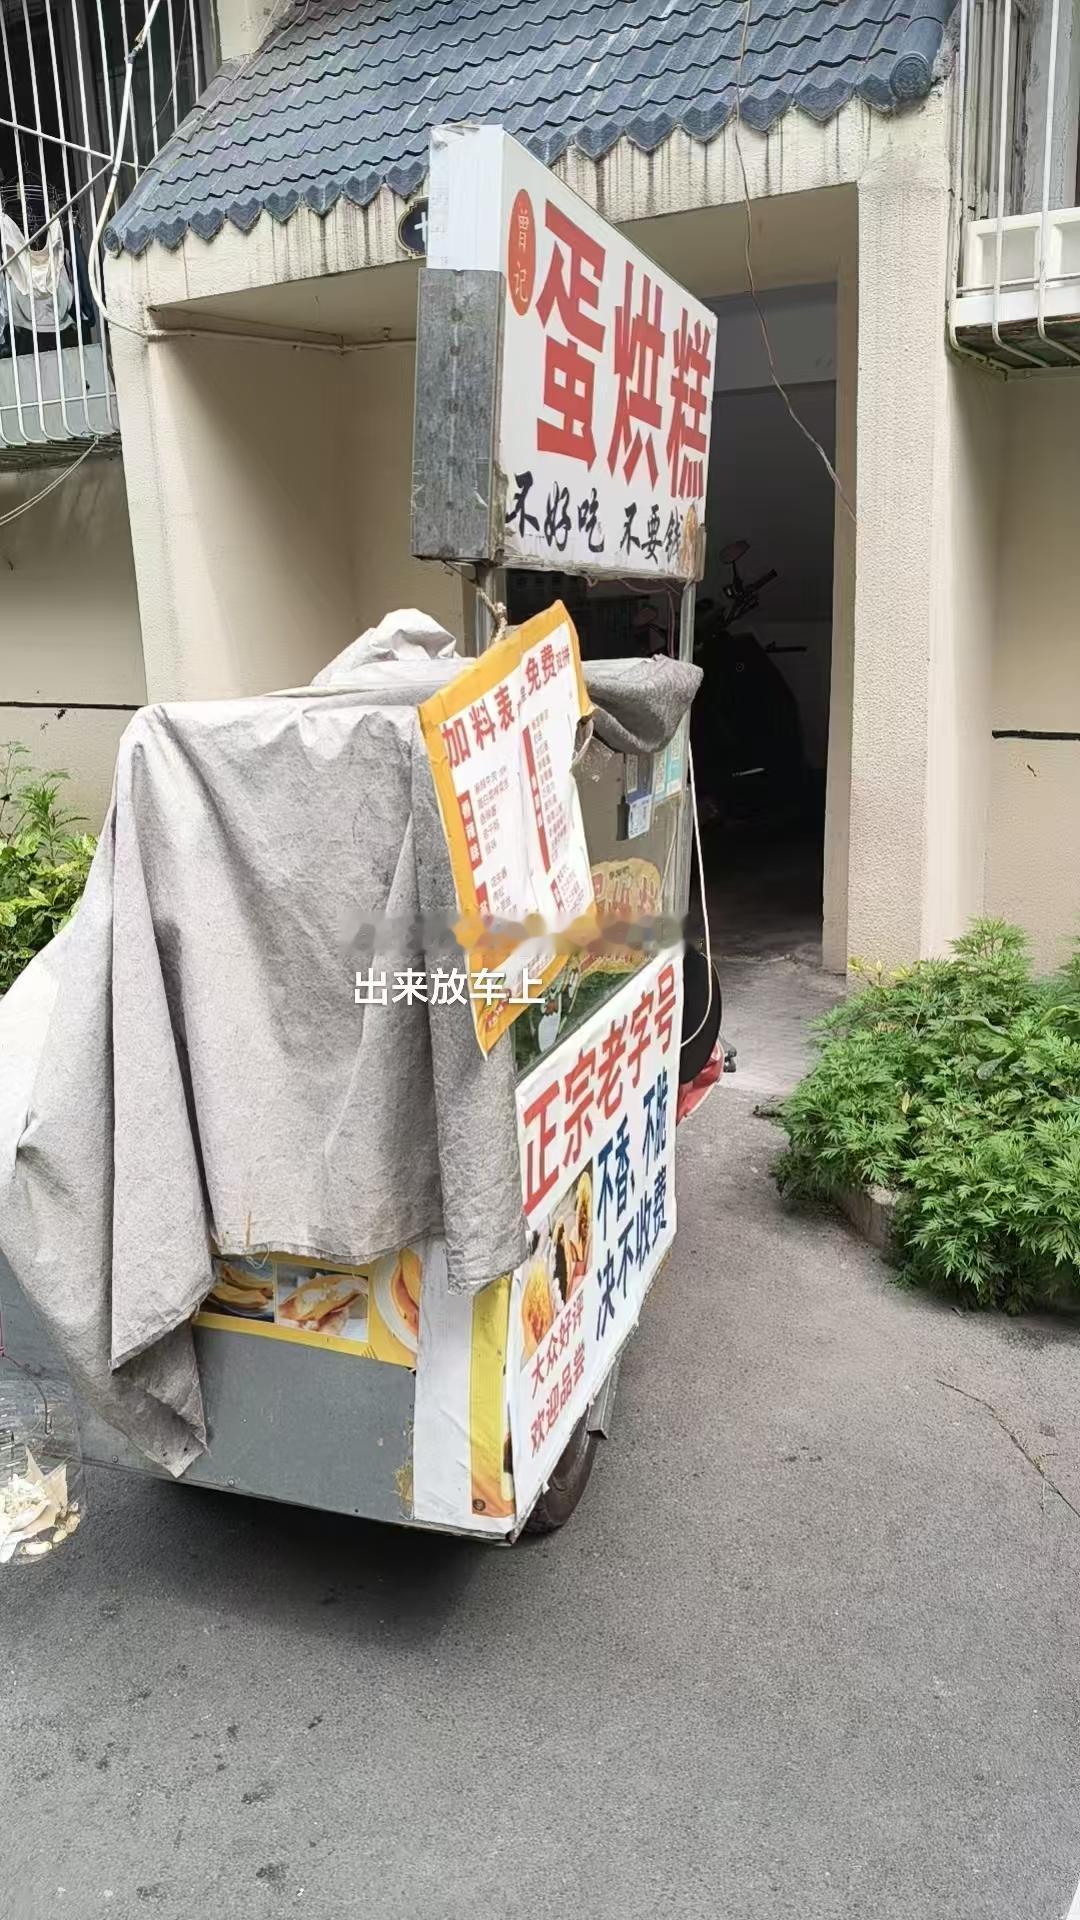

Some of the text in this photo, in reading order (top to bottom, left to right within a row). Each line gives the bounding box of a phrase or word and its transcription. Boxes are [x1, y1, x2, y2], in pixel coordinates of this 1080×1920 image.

[535, 198, 711, 500] 蛋烘糕
[505, 470, 683, 564] 不好吃 不要钱
[441, 685, 515, 768] 加料表
[524, 964, 676, 1215] 正宗老字号
[596, 1165, 667, 1342] 决不收费
[530, 1337, 585, 1458] 欢迎品尝
[531, 1289, 584, 1400] 大众好评
